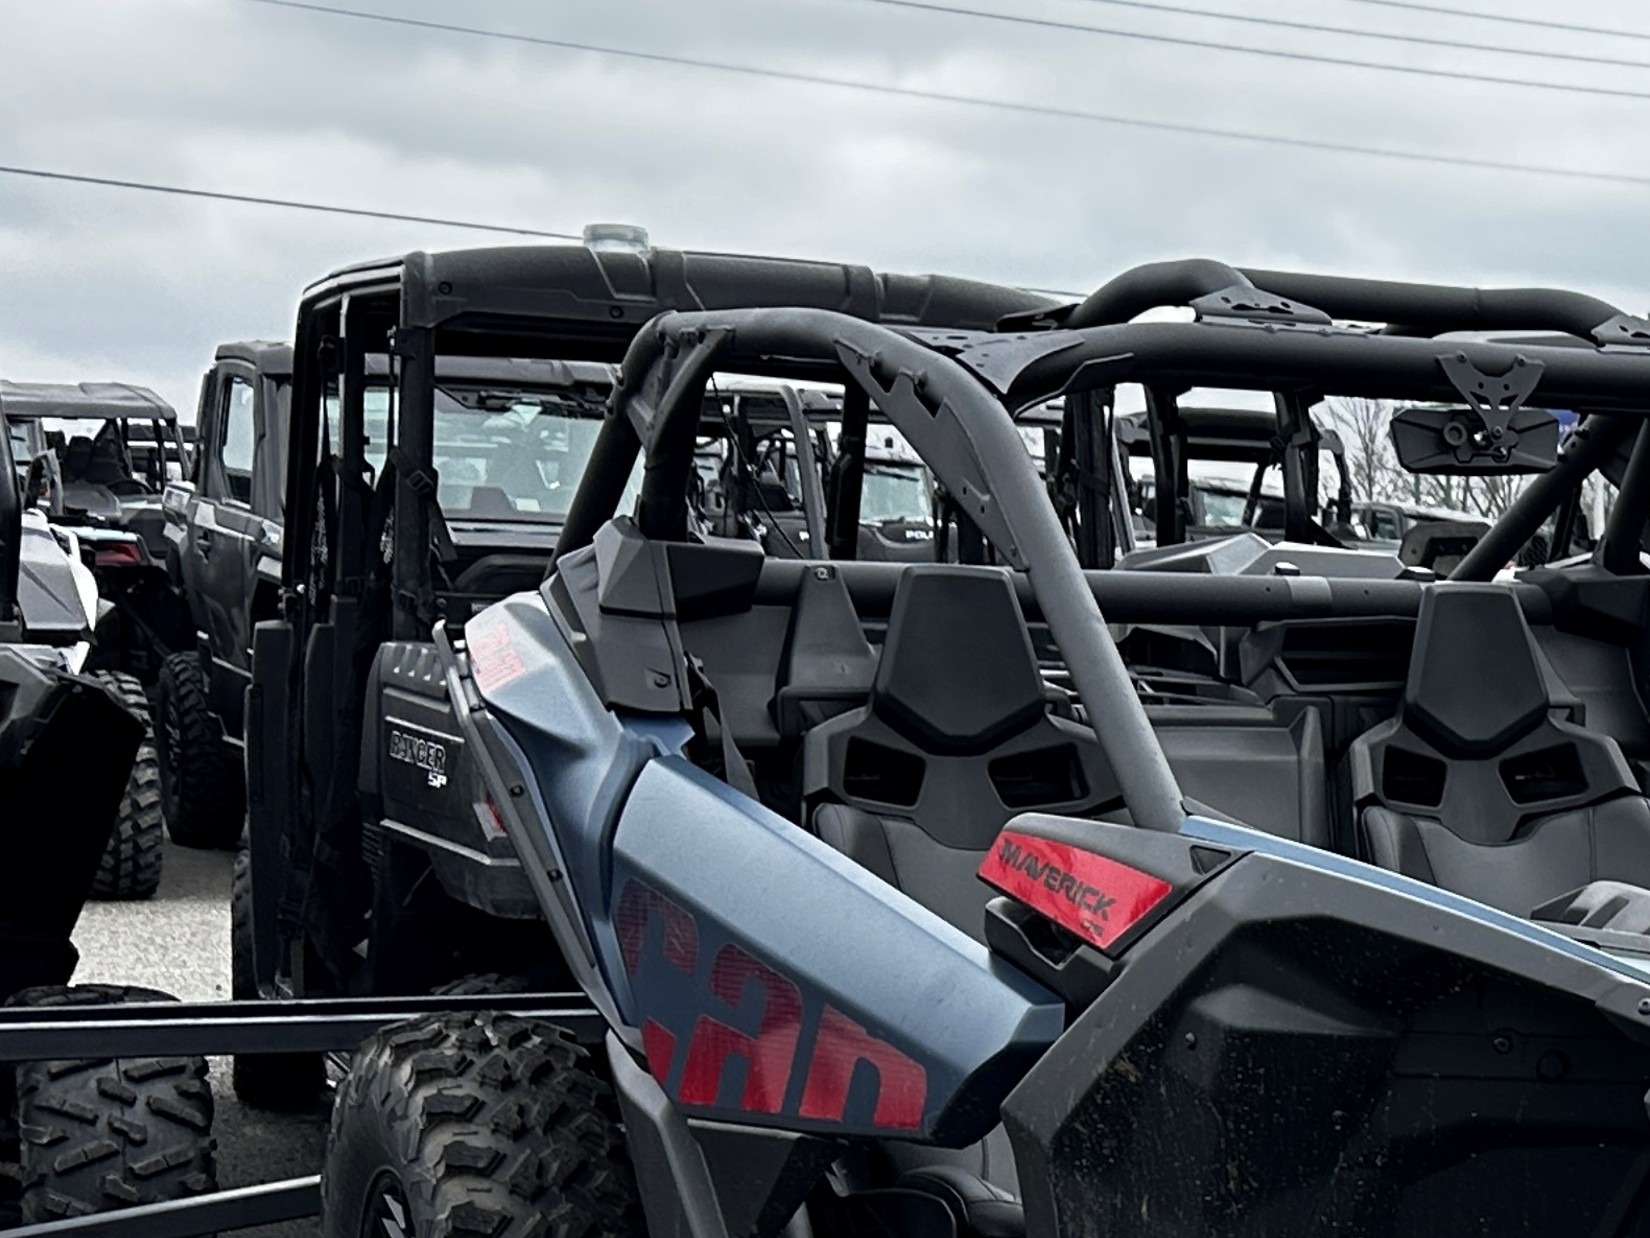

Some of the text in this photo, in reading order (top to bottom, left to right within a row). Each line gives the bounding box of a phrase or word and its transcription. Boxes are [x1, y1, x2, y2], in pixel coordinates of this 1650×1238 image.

[389, 730, 447, 774] RANGER
[427, 771, 448, 788] SP
[998, 838, 1117, 921] MAVERICK
